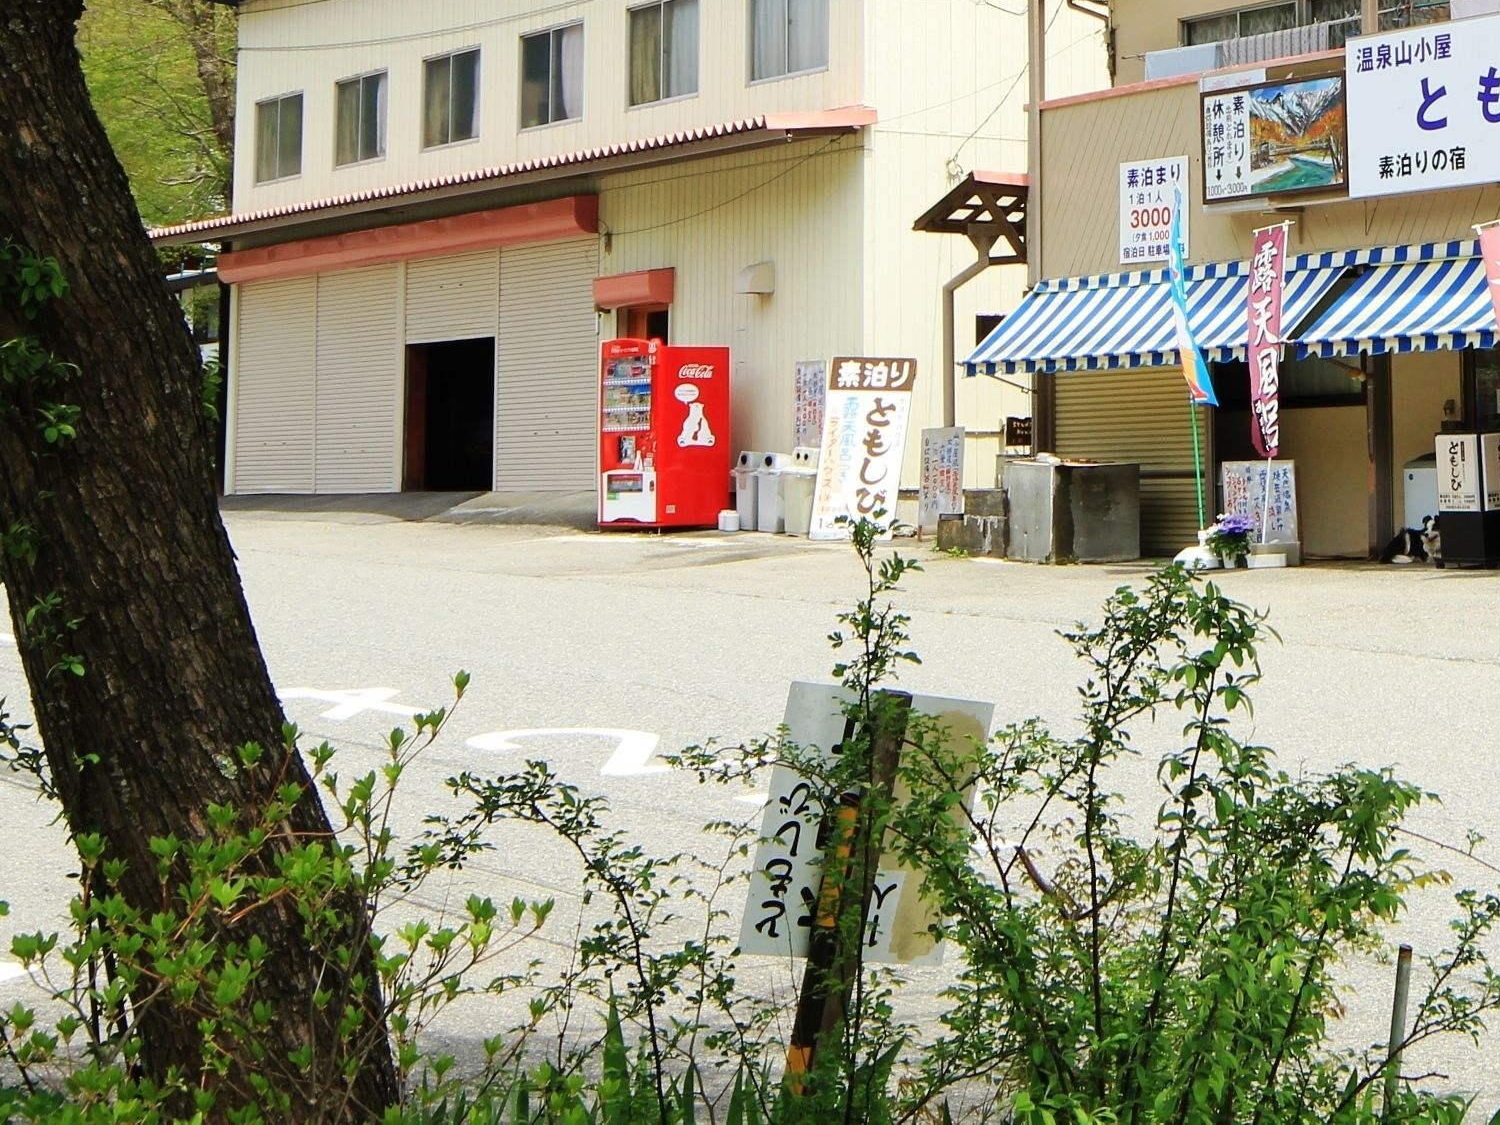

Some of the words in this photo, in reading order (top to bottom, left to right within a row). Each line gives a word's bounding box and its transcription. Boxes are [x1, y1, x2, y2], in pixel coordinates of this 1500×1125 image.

[1356, 33, 1452, 73] 温泉山小屋
[1212, 99, 1225, 168] 休憩所
[1233, 95, 1245, 162] 素泊り
[1127, 163, 1181, 188] 素泊まり
[1378, 146, 1466, 179] 素泊りの宿
[838, 361, 910, 388] 素泊り
[855, 397, 896, 514] ともしび
[1448, 441, 1462, 492] ともしび
